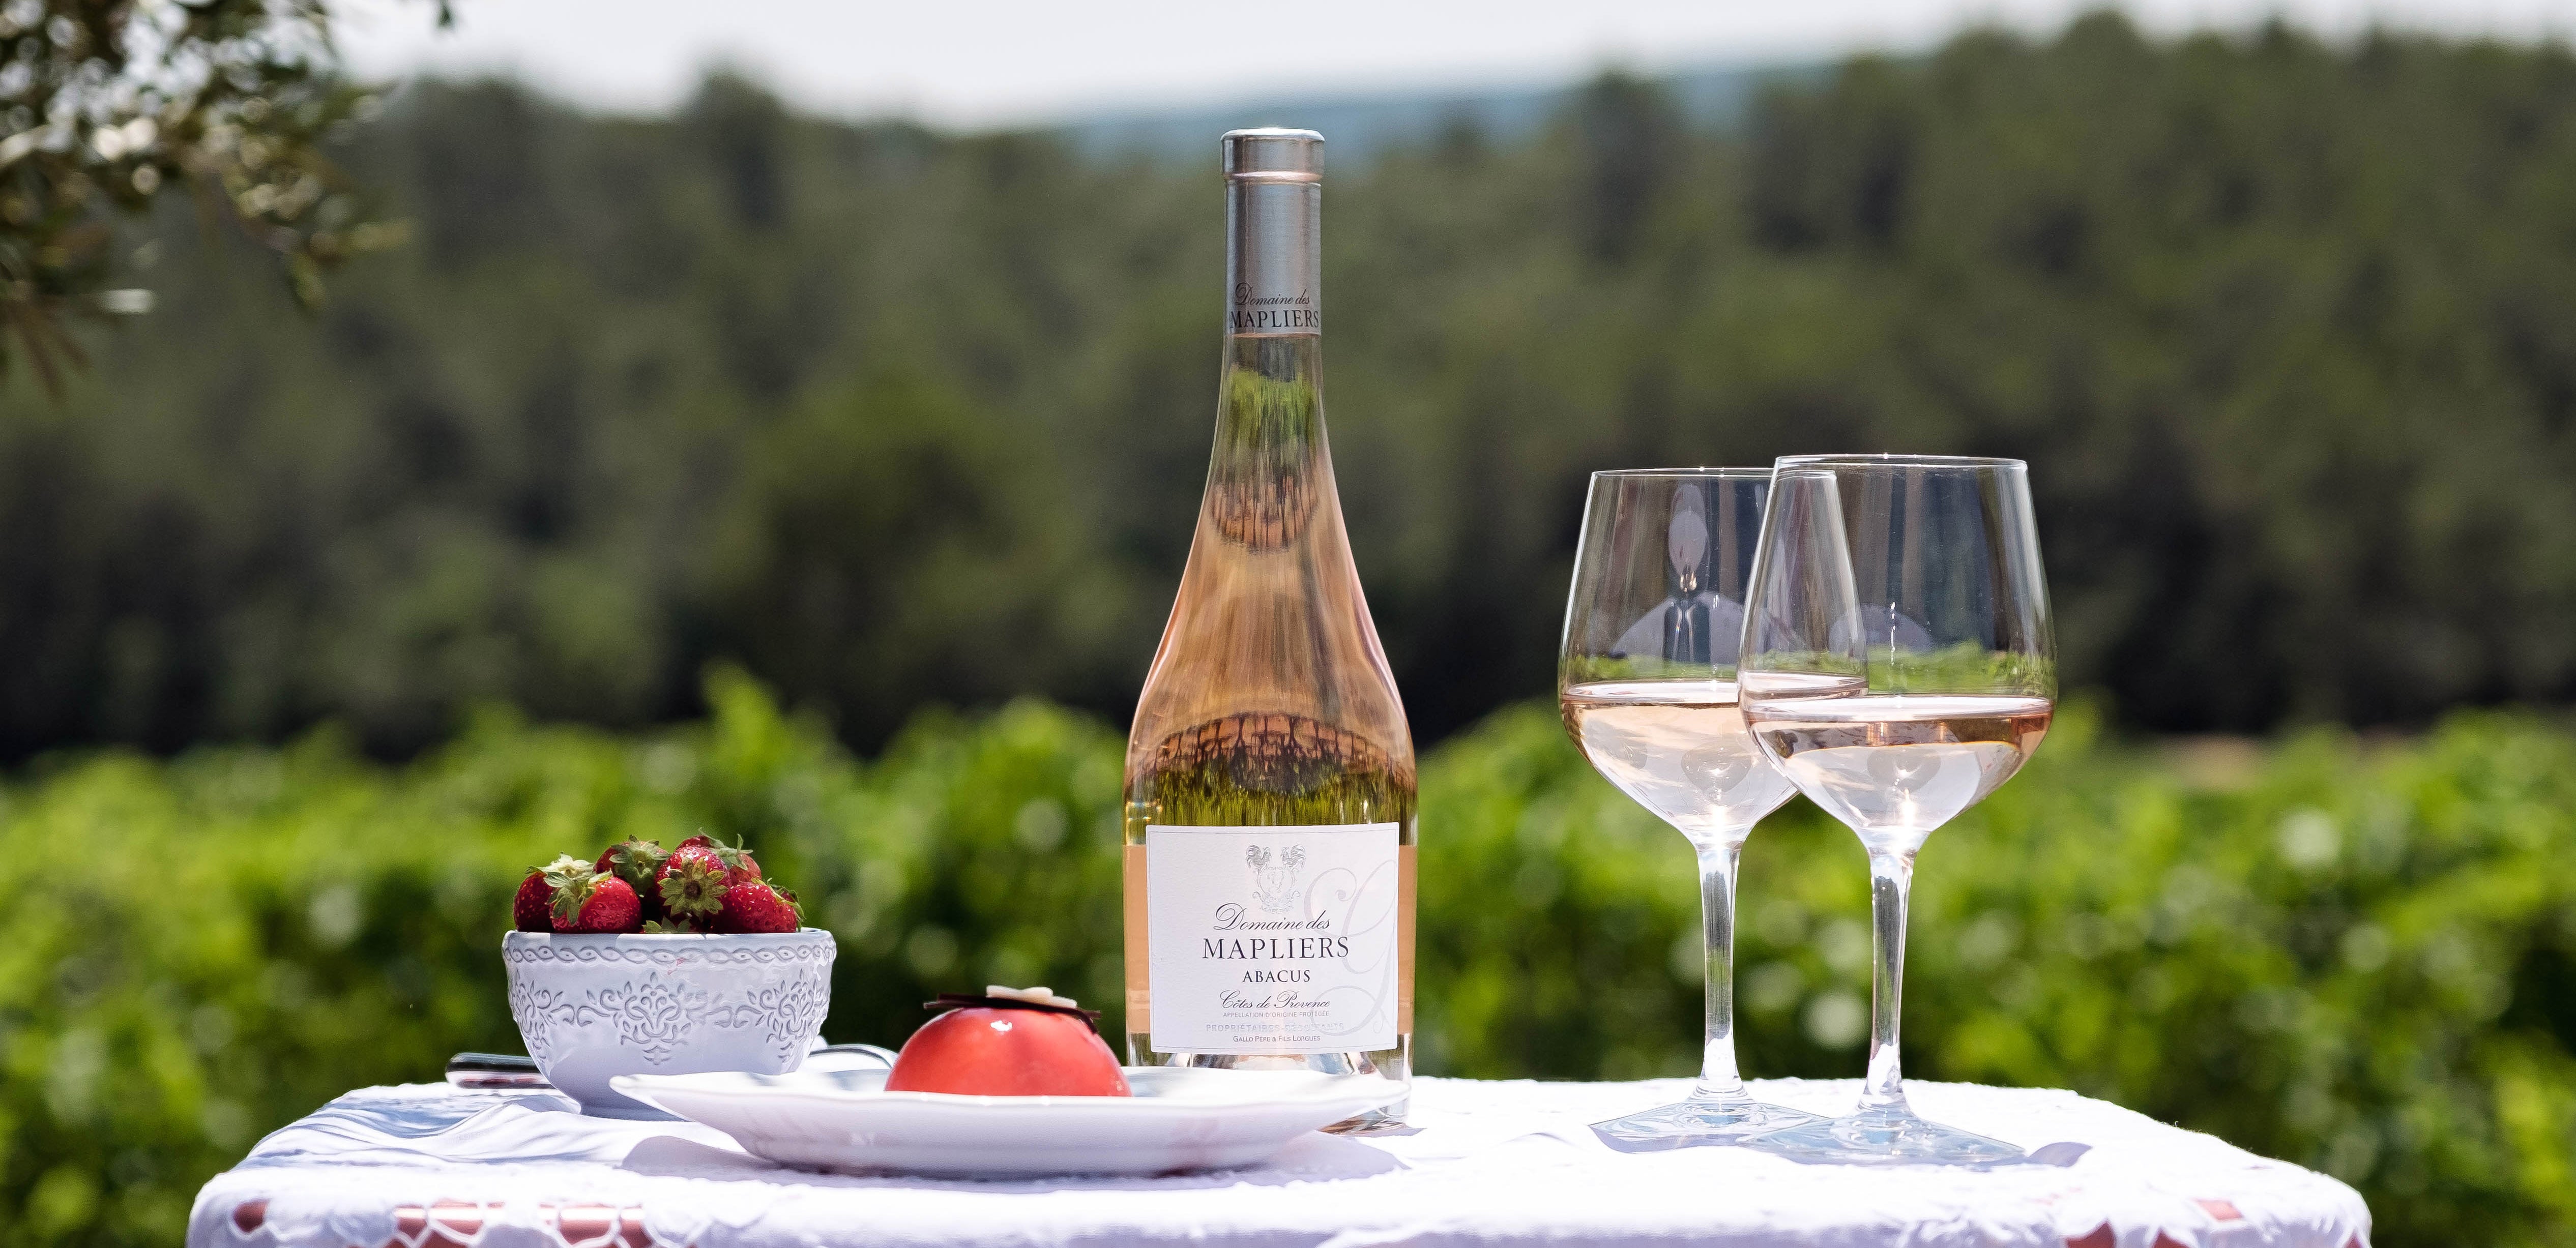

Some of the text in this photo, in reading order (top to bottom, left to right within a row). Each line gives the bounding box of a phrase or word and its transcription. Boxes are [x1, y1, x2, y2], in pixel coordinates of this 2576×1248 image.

[1235, 282, 1310, 305] Domaine des
[1230, 310, 1319, 328] MAPLIERS
[1213, 903, 1331, 931] Domaine des
[1202, 936, 1349, 959] MAPLIERS
[1242, 970, 1311, 983] ABACUS
[1220, 990, 1331, 1009] Côtes de Provence
